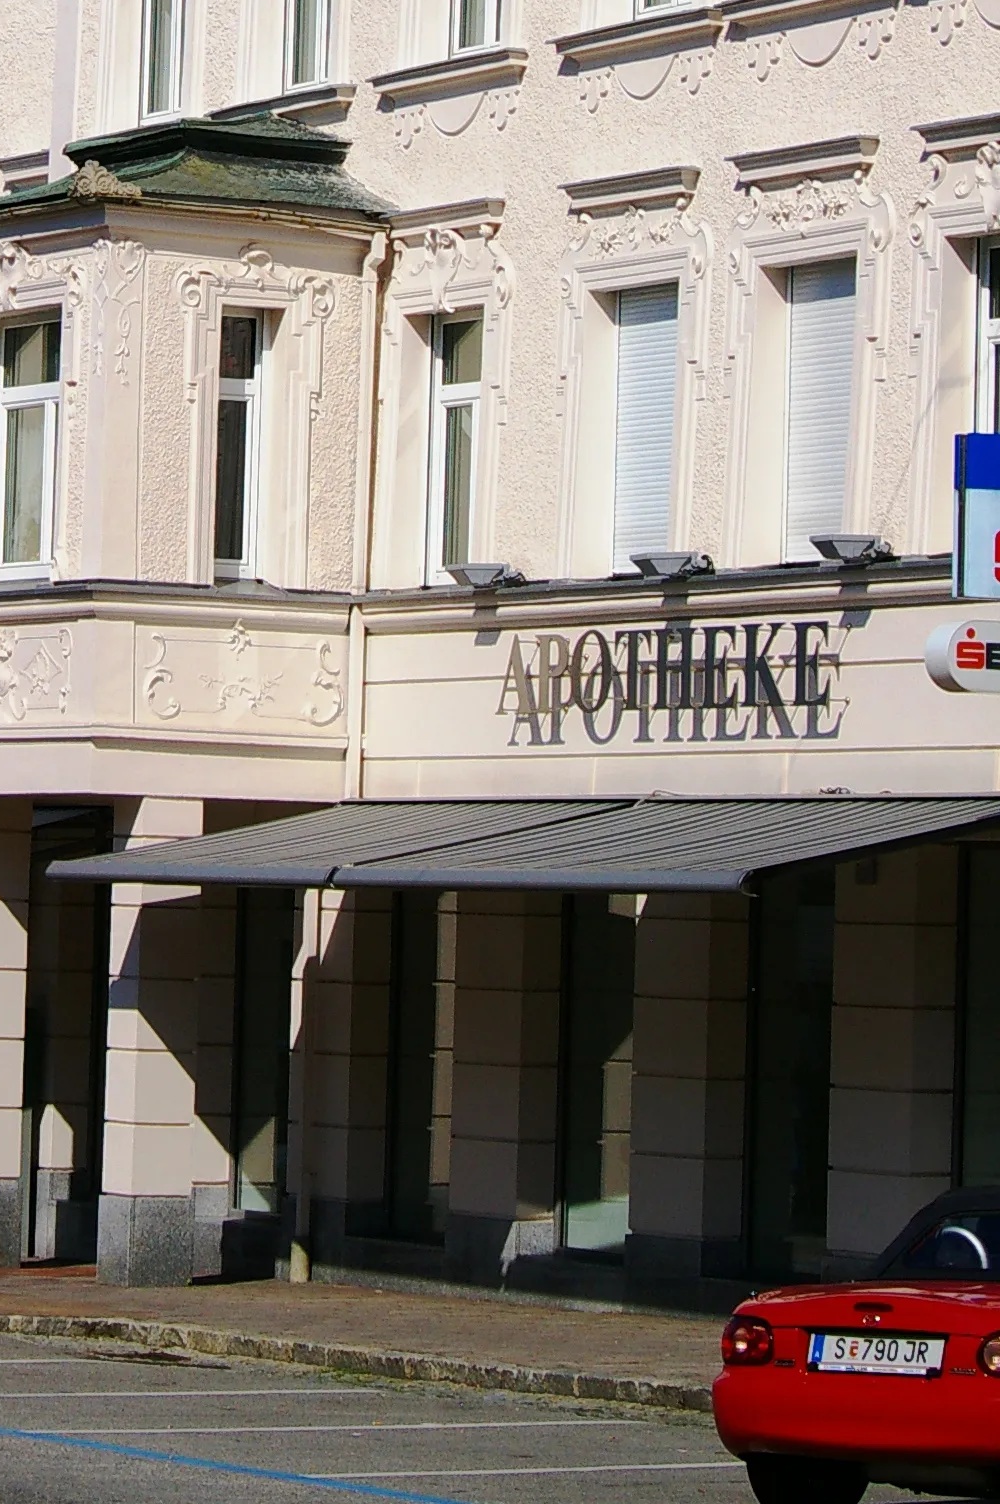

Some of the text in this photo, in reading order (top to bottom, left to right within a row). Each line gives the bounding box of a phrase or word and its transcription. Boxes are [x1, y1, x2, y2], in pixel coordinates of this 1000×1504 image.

[495, 621, 829, 715] APOTHEKE
[834, 1337, 929, 1364] S 790 JR
